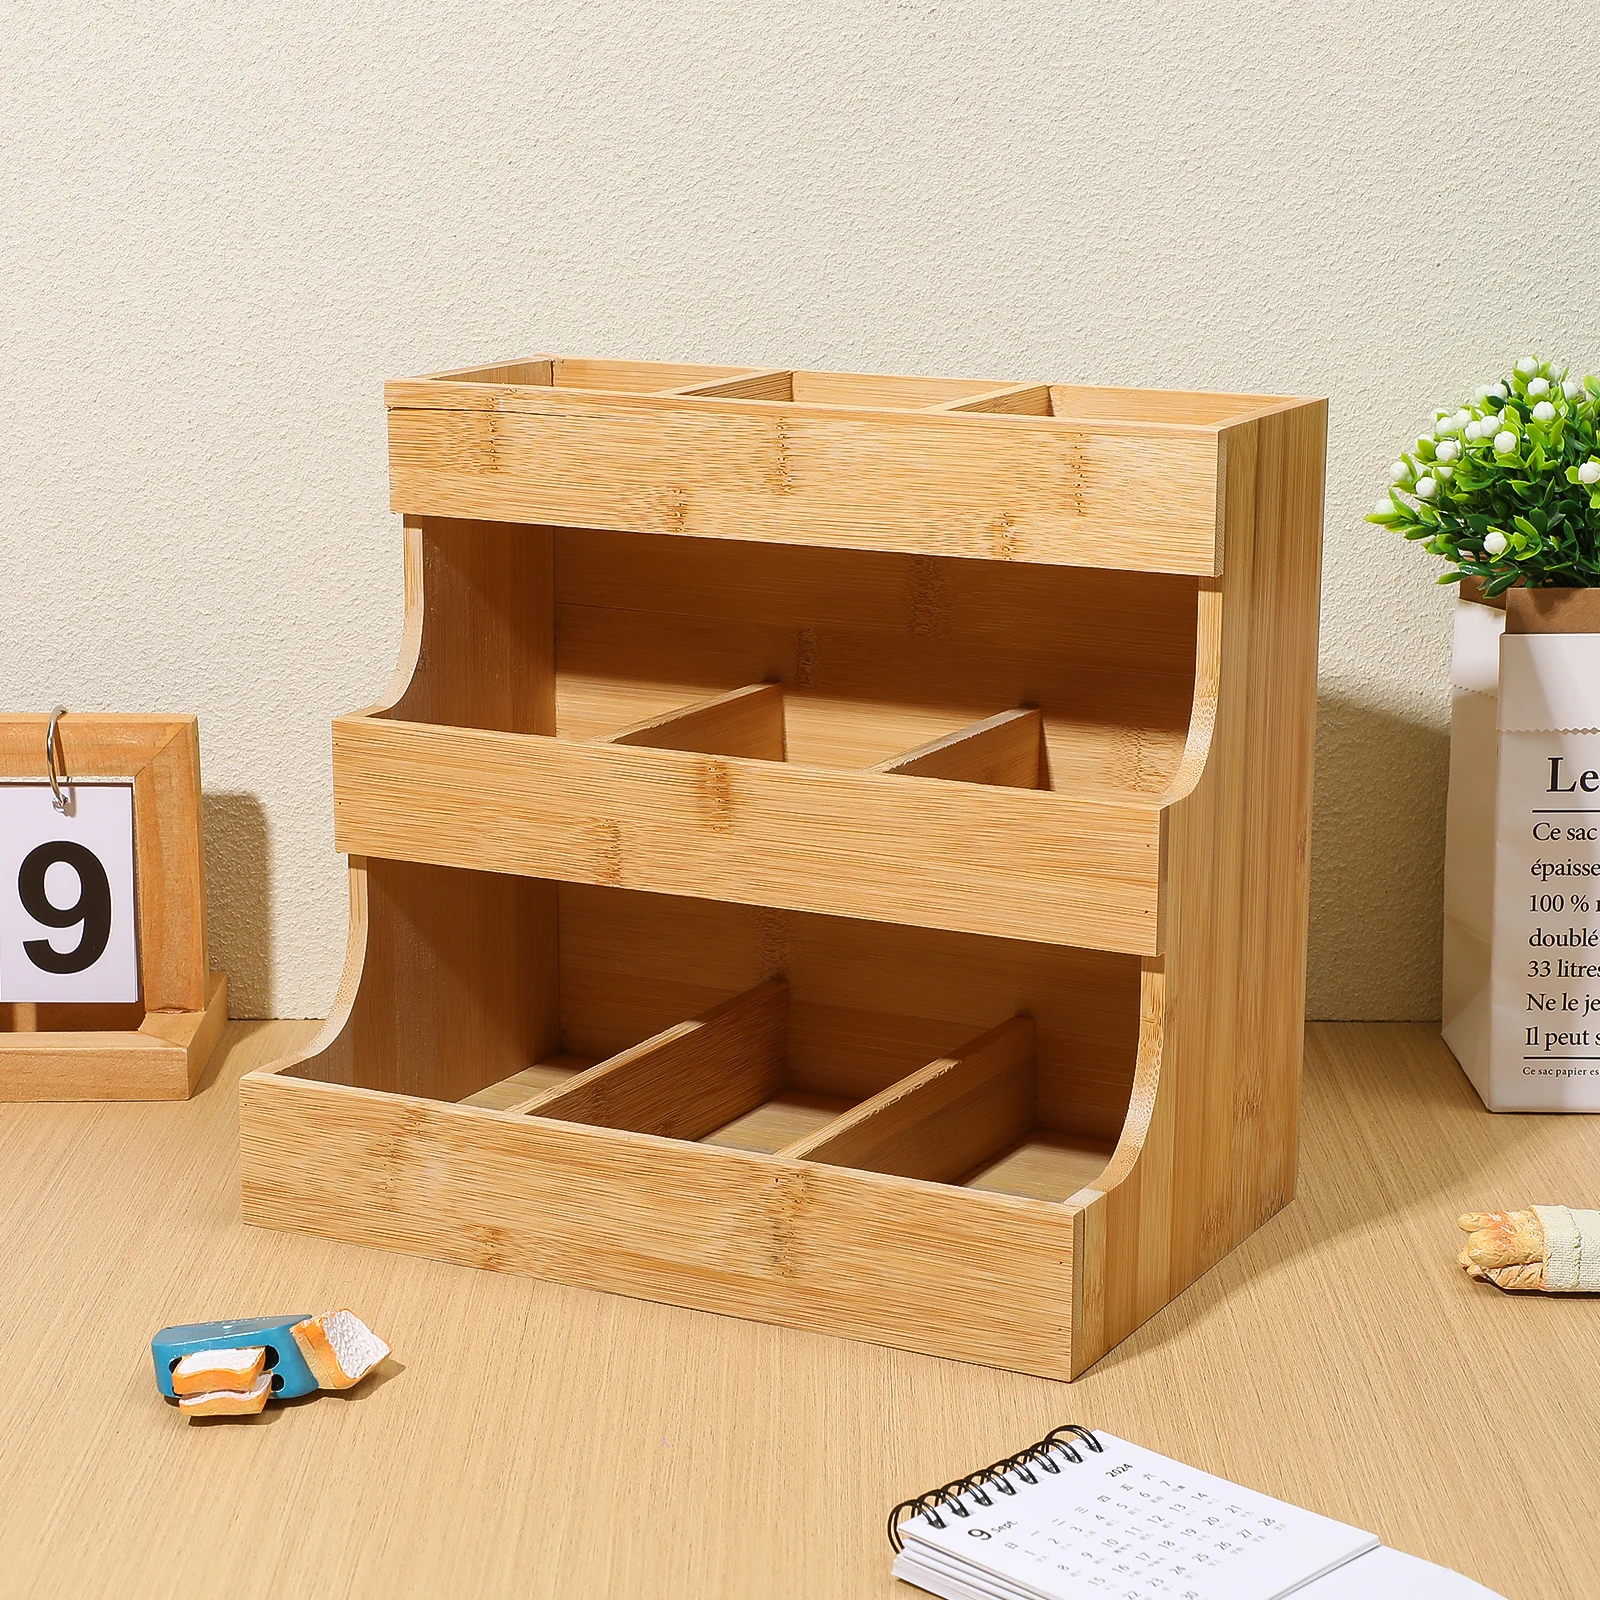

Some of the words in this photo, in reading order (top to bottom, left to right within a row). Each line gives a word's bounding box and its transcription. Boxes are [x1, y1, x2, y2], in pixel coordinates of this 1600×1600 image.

[1546, 757, 1600, 793] Le
[1532, 822, 1562, 841] Ce
[1566, 827, 1598, 841] sac
[1530, 858, 1600, 882] épaisse
[18, 840, 112, 975] 9
[1530, 894, 1565, 913] 100
[1570, 894, 1590, 913] %
[1528, 927, 1599, 948] doublé
[1527, 960, 1551, 978] 33
[1526, 993, 1557, 1011] Ne
[1561, 992, 1579, 1011] le
[1582, 993, 1600, 1018] je
[1525, 1026, 1541, 1046] Il
[1545, 1029, 1590, 1052] peut
[1522, 1066, 1536, 1076] Ce
[1538, 1068, 1554, 1076] sac
[1555, 1067, 1588, 1078] papier
[1105, 1463, 1134, 1478] 2024
[1047, 1537, 1060, 1545] 2
[1116, 1502, 1128, 1510] 5
[1101, 1538, 1119, 1548] 10
[1125, 1526, 1142, 1536] 11
[1147, 1515, 1165, 1524] 12
[1169, 1503, 1187, 1513] 13
[1191, 1492, 1208, 1501] 14
[968, 1528, 993, 1541] 9
[1088, 1577, 1106, 1587] 15
[1112, 1564, 1130, 1574] 16
[1135, 1552, 1151, 1562] 17
[1158, 1540, 1176, 1550] 18
[1180, 1528, 1197, 1538] 19
[1202, 1516, 1220, 1526] 20
[1225, 1504, 1243, 1514] 21
[1146, 1577, 1165, 1588] 23
[1169, 1565, 1188, 1576] 24
[1192, 1552, 1210, 1563] 25
[1214, 1540, 1232, 1551] 26
[1236, 1528, 1253, 1539] 27
[1258, 1517, 1276, 1527] 28
